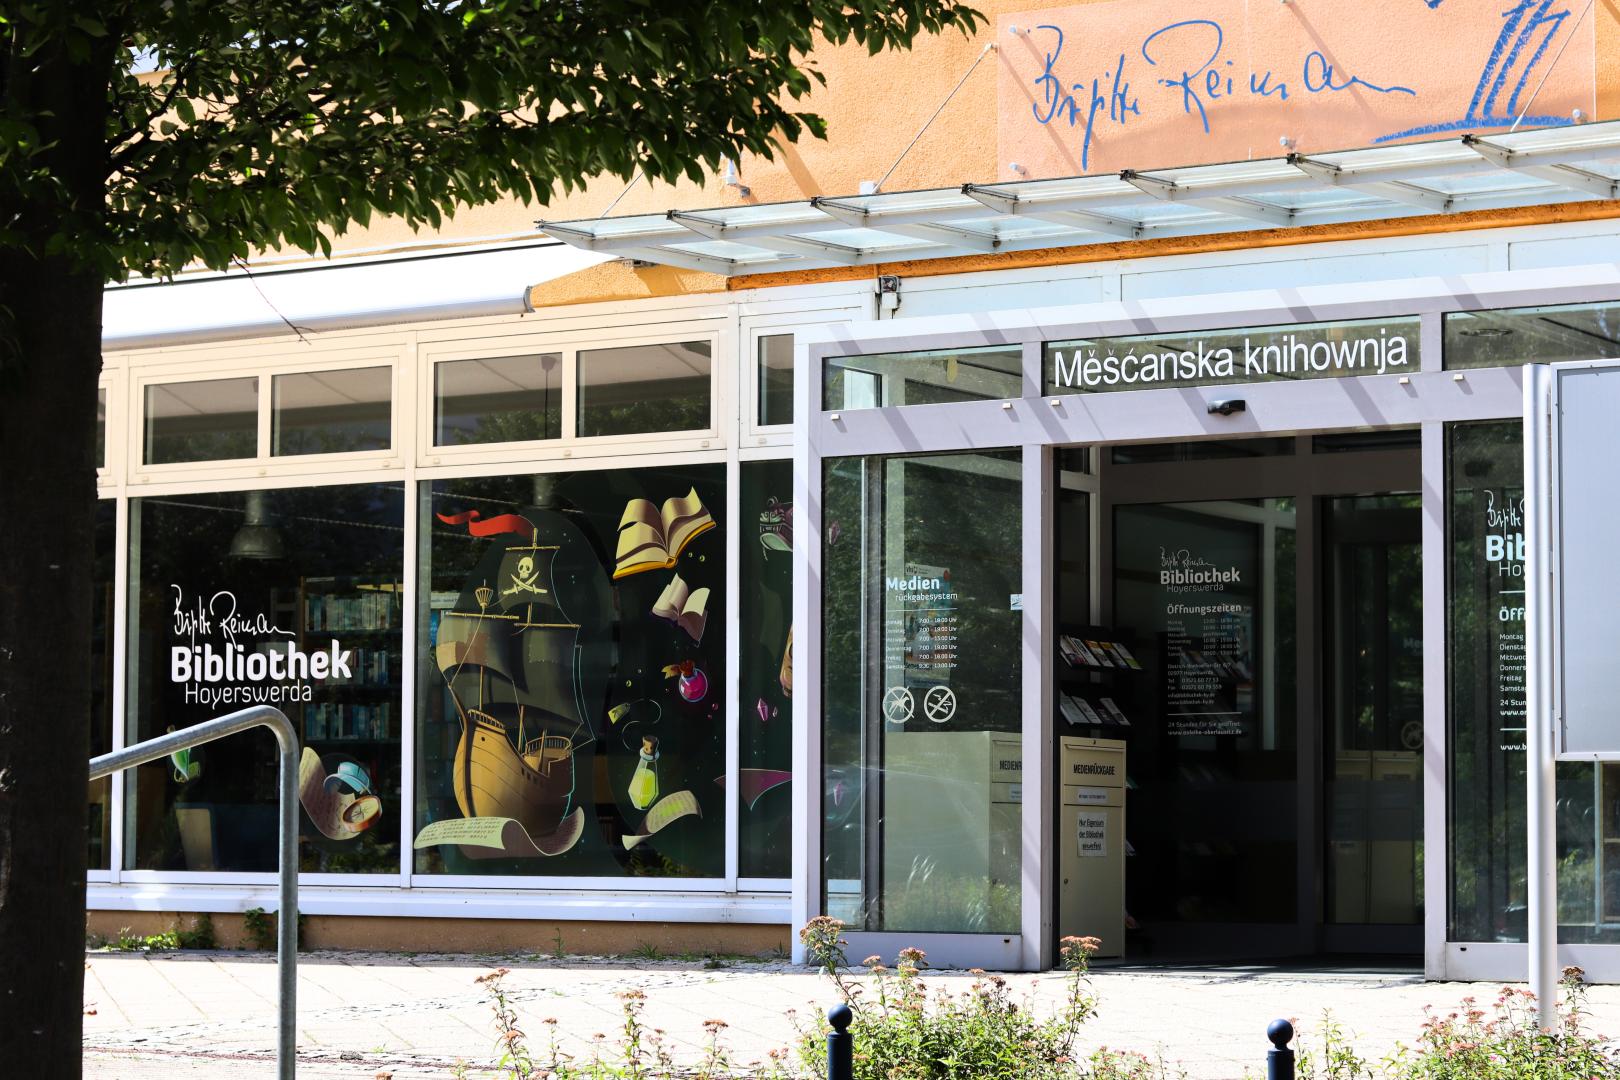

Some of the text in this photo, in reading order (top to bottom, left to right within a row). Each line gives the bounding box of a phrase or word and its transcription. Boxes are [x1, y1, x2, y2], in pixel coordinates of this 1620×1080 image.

[1054, 328, 1408, 388] Měšćanska knihownja
[1160, 566, 1240, 585] Bibliothek
[1499, 561, 1525, 580] Ho
[886, 576, 940, 591] Medien
[1166, 582, 1224, 595] Hoyerswerda
[895, 592, 958, 602] rückgabesystem
[1167, 603, 1242, 616] Öffnungszeiten
[1499, 606, 1526, 621] Öff
[171, 639, 352, 683] Bibliothek
[185, 679, 312, 710] Hoyerswerda
[1073, 763, 1115, 776] MEDIENRÜCKGABE
